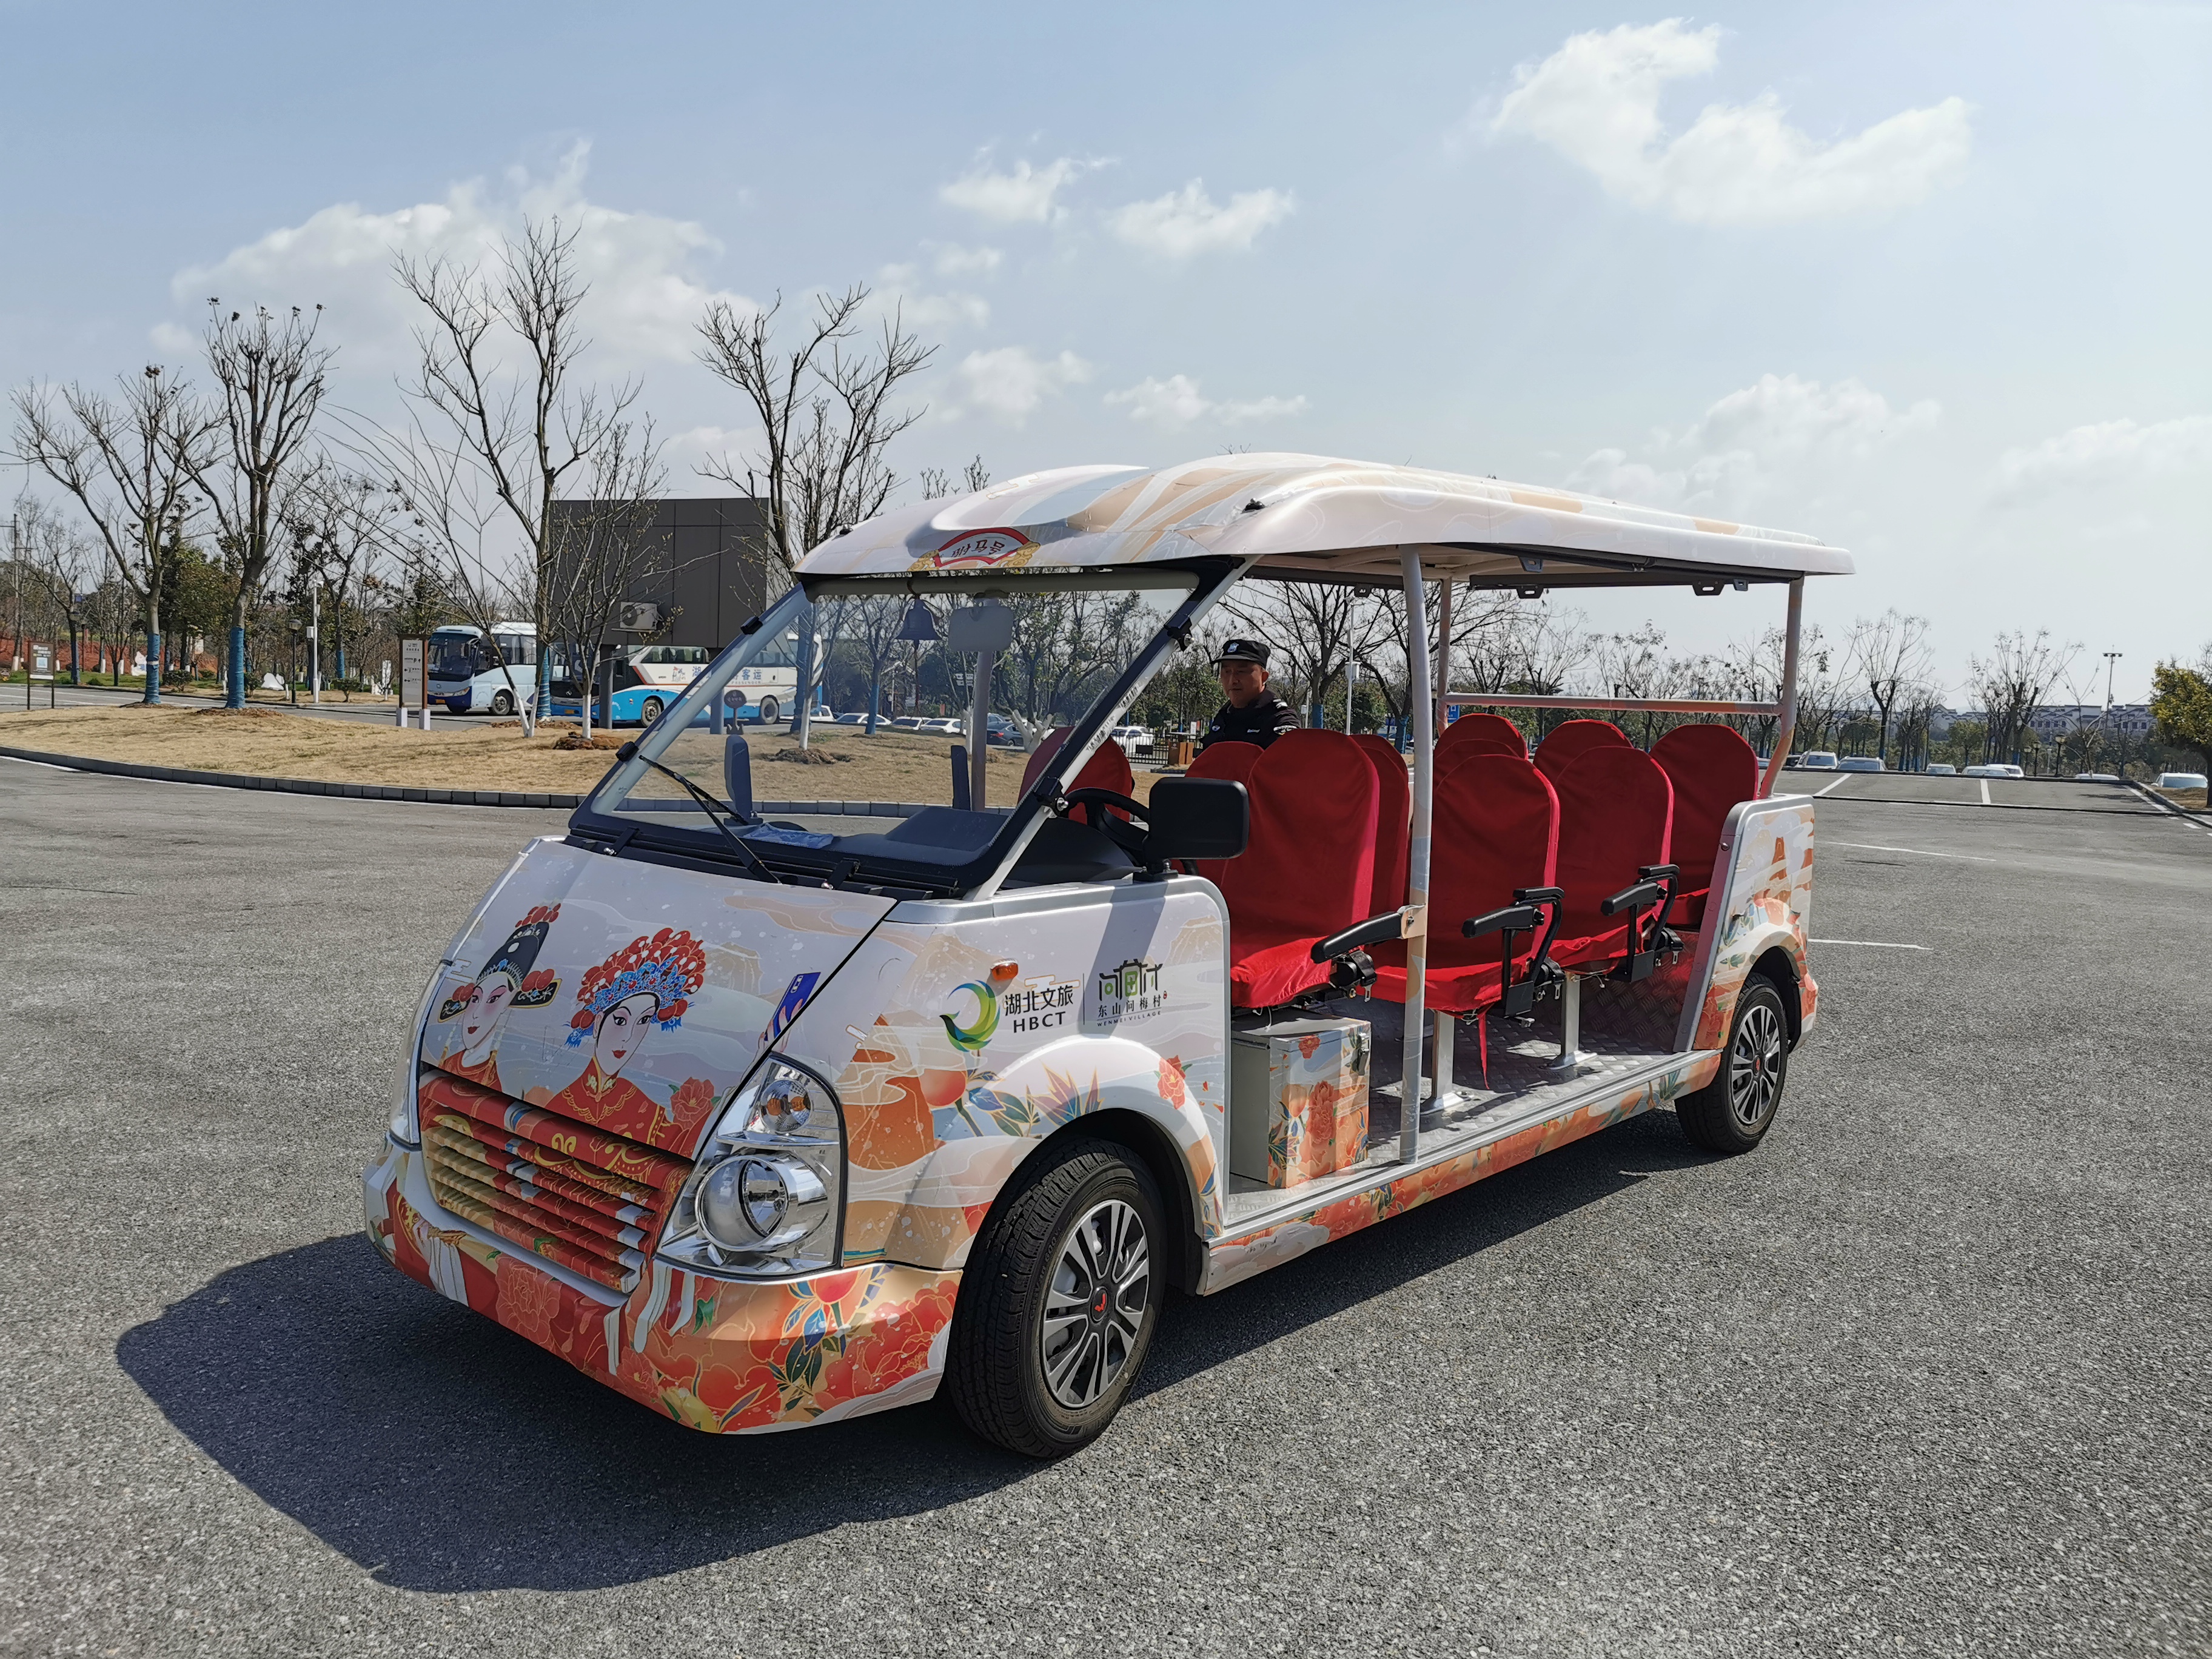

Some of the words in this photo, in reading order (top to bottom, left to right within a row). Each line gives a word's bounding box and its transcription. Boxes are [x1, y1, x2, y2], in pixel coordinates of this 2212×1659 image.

[1005, 985, 1074, 1017] 湖北文旅
[1098, 994, 1161, 1018] 东山问梅村
[1013, 1011, 1067, 1033] HBCT
[1128, 1010, 1161, 1021] VILLAGE
